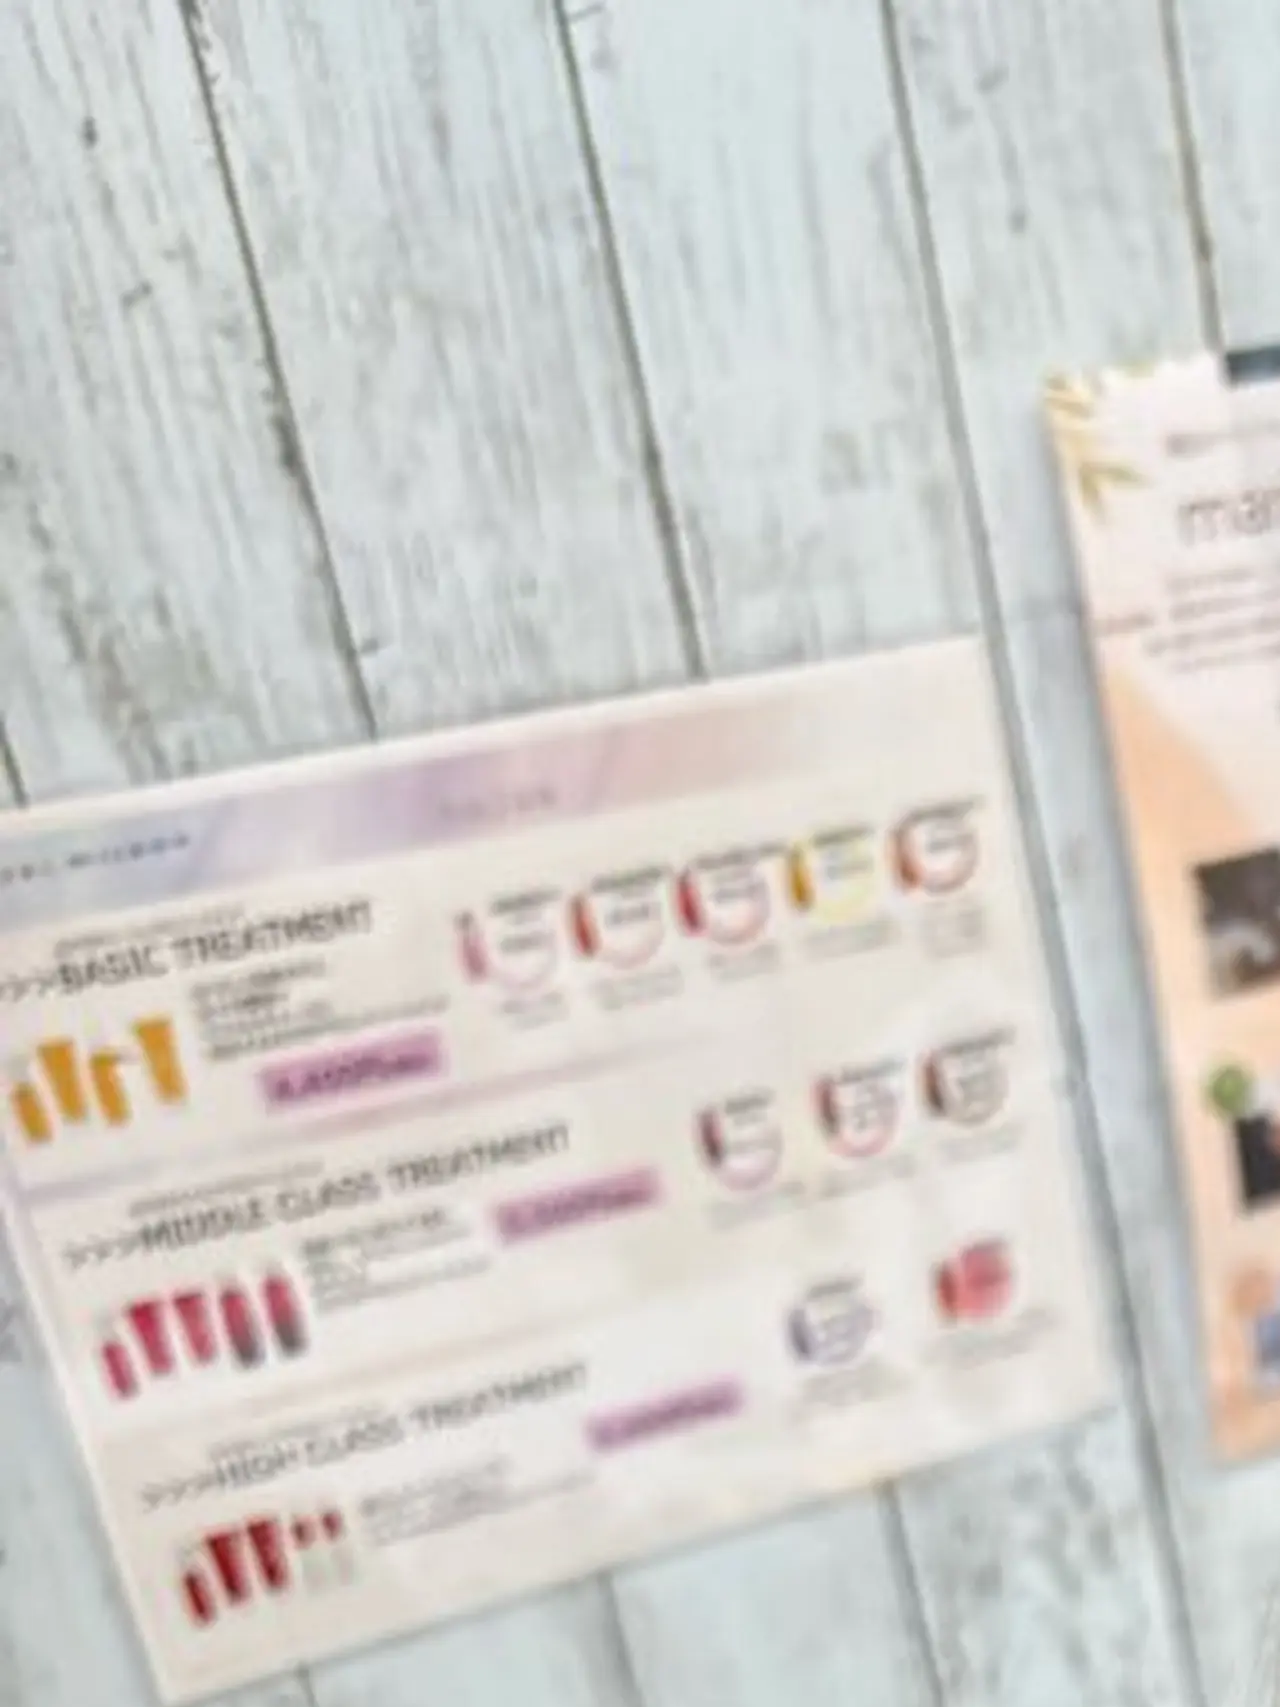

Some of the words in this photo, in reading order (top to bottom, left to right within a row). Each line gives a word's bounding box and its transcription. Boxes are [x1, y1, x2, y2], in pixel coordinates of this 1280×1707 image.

[172, 899, 373, 966] TREATMENT
[277, 1171, 381, 1224] CLASS
[390, 1121, 571, 1190] TREATMENT
[410, 1361, 588, 1430] TREATMENT
